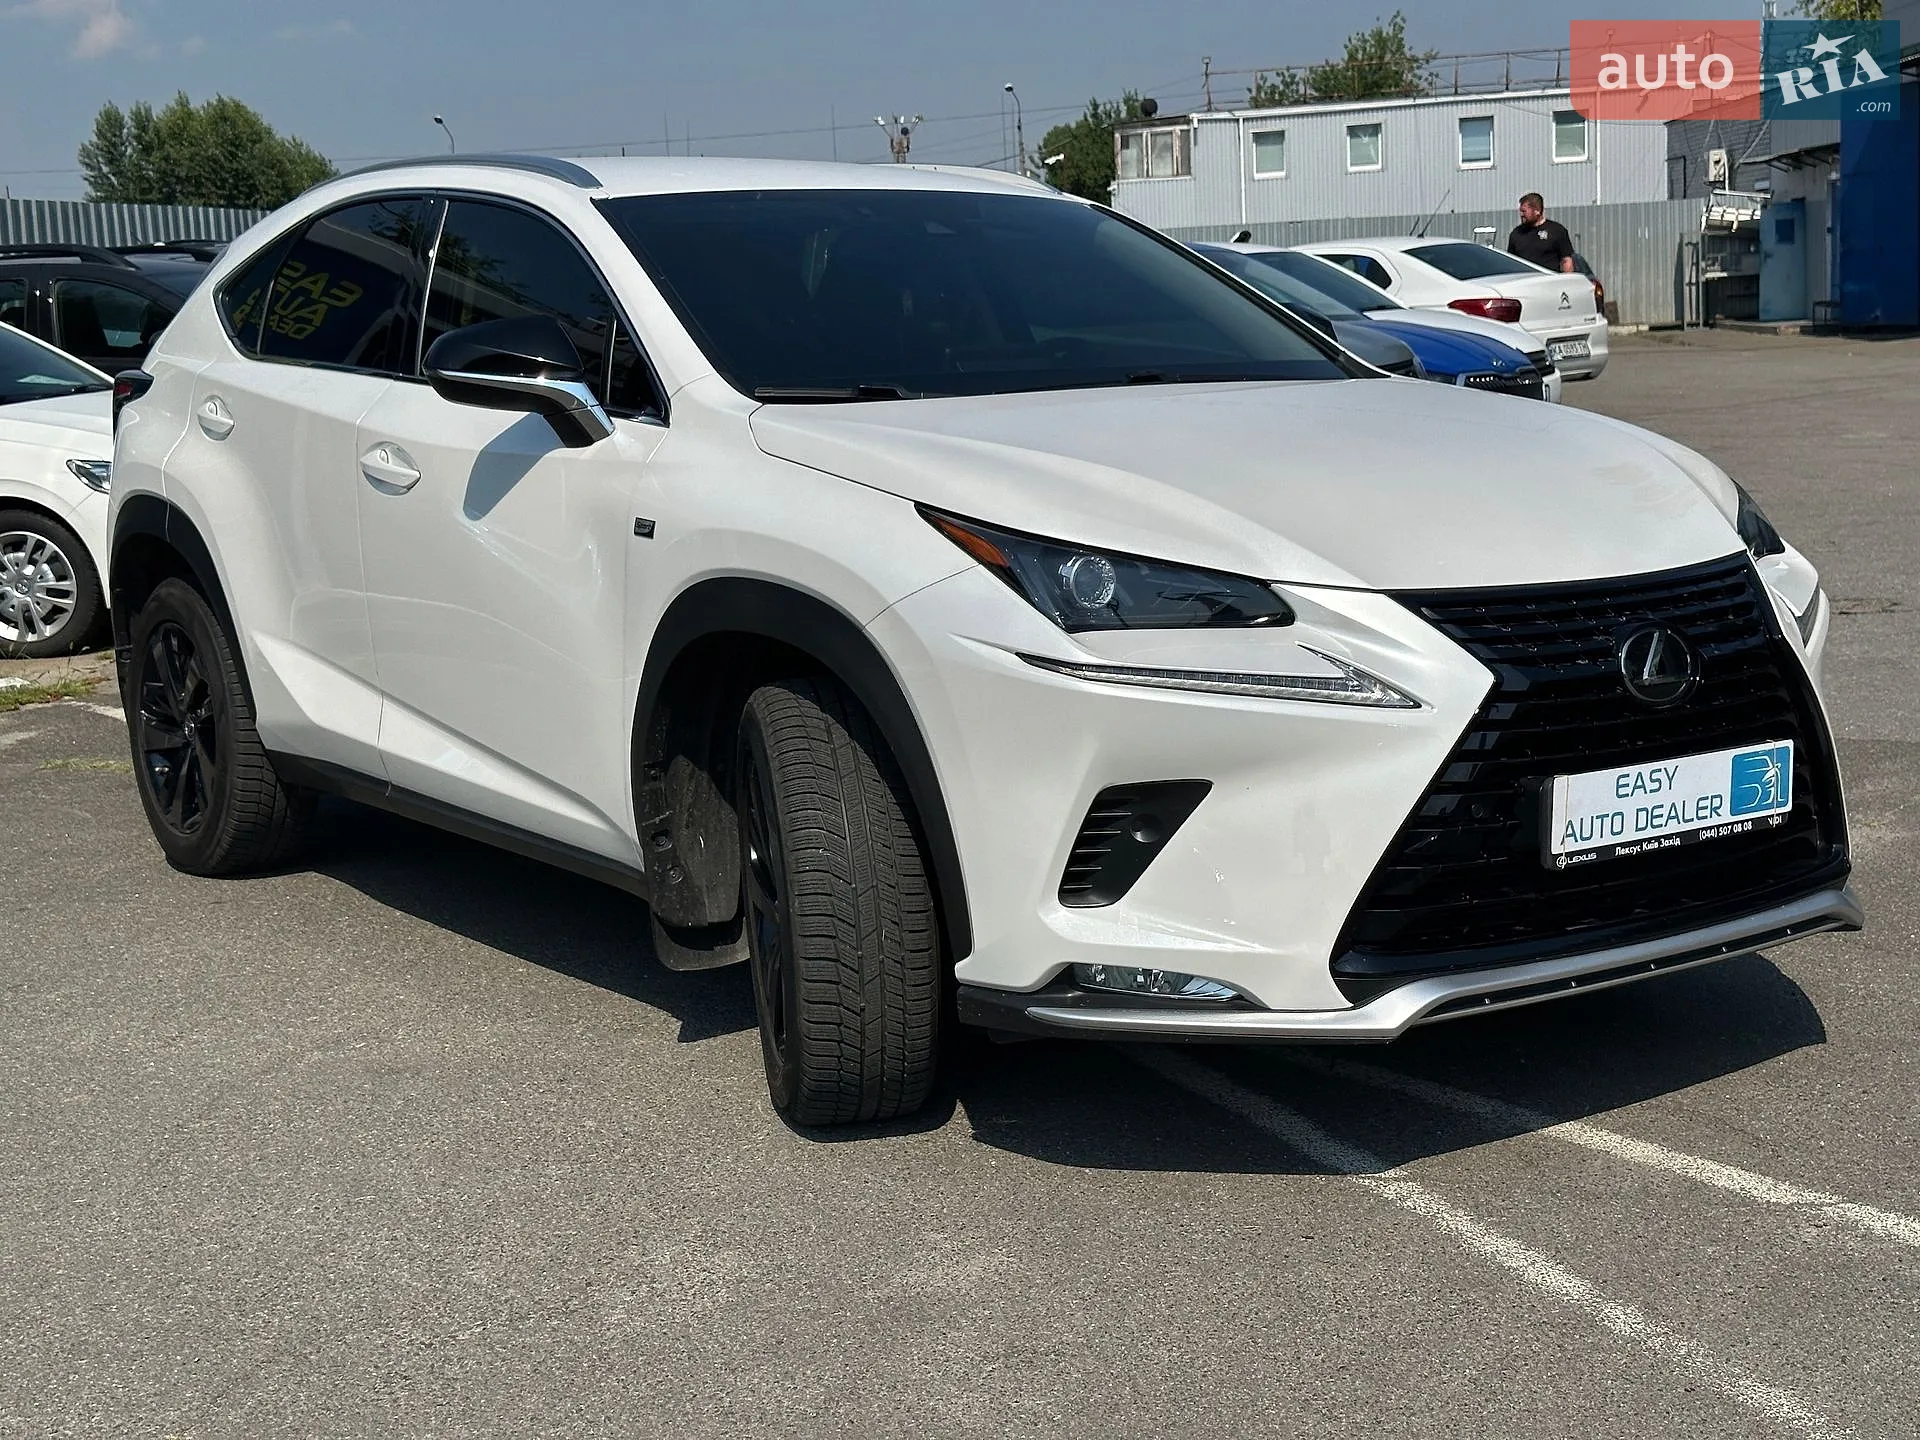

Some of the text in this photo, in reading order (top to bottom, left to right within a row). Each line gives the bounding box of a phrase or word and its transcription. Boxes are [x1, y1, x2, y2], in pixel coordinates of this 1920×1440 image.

[1616, 765, 1679, 799] EASY
[1560, 794, 1723, 845] AUTO DEALER
[1700, 827, 1717, 840] (044)
[1719, 825, 1731, 836] 507
[1615, 836, 1681, 856] Лексус Київ Захід
[1567, 853, 1597, 863] LEXUS
